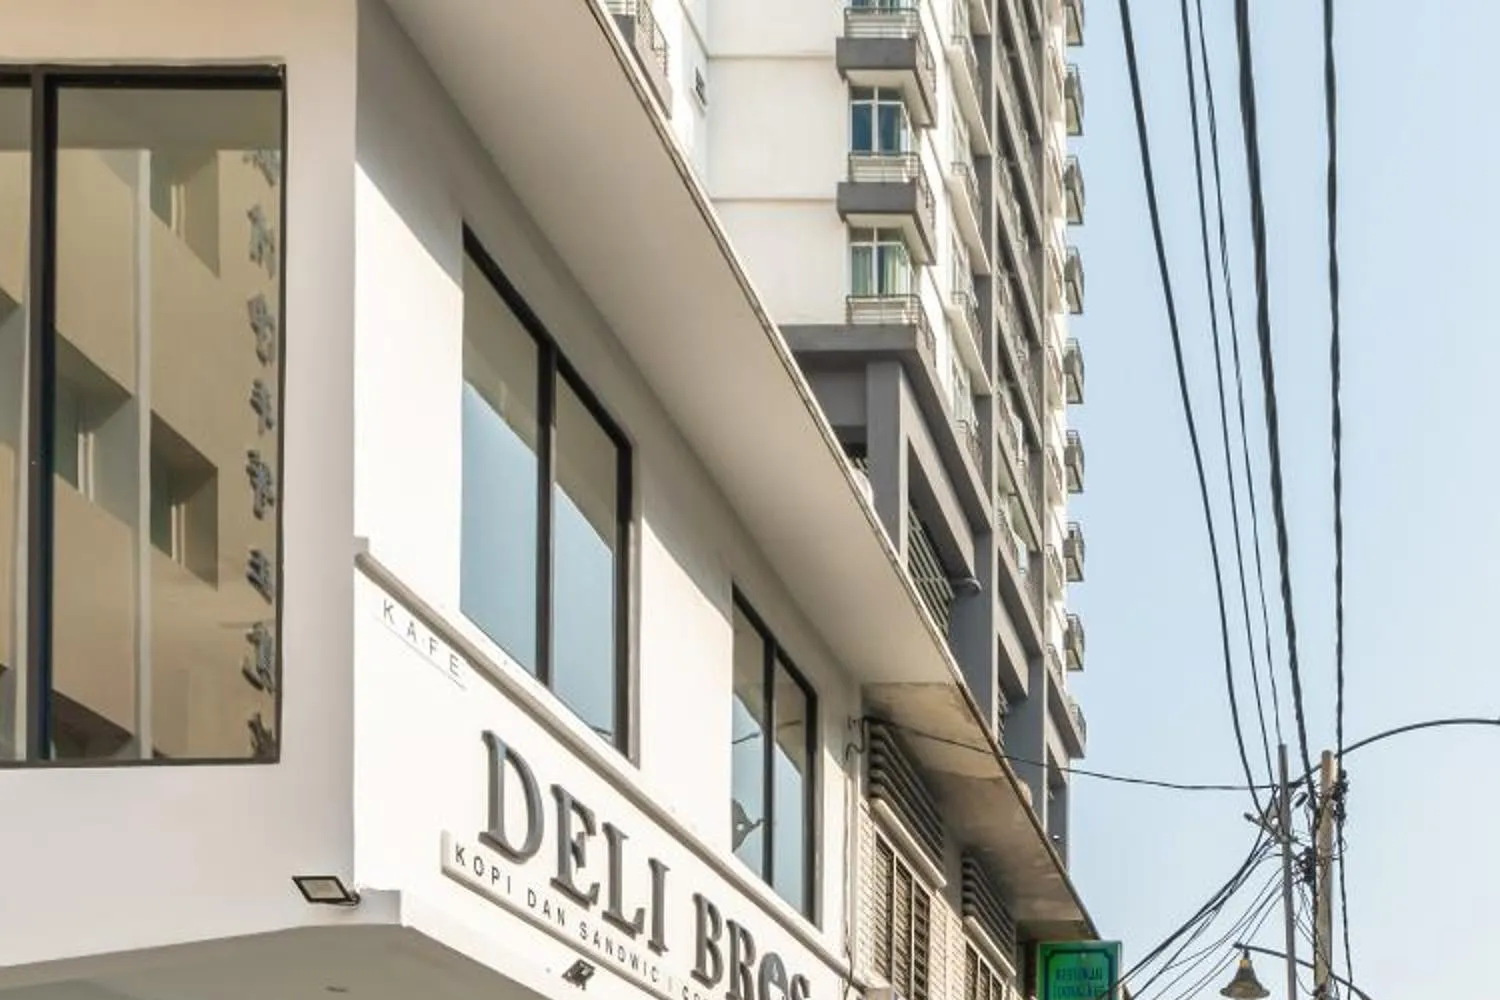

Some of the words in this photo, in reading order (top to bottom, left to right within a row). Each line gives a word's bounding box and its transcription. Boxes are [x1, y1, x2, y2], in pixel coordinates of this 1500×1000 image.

[383, 599, 460, 679] KAFE
[455, 843, 511, 894] KOPI
[527, 888, 565, 927] DAN
[579, 921, 660, 983] SANDWIC
[478, 730, 671, 957] DELI
